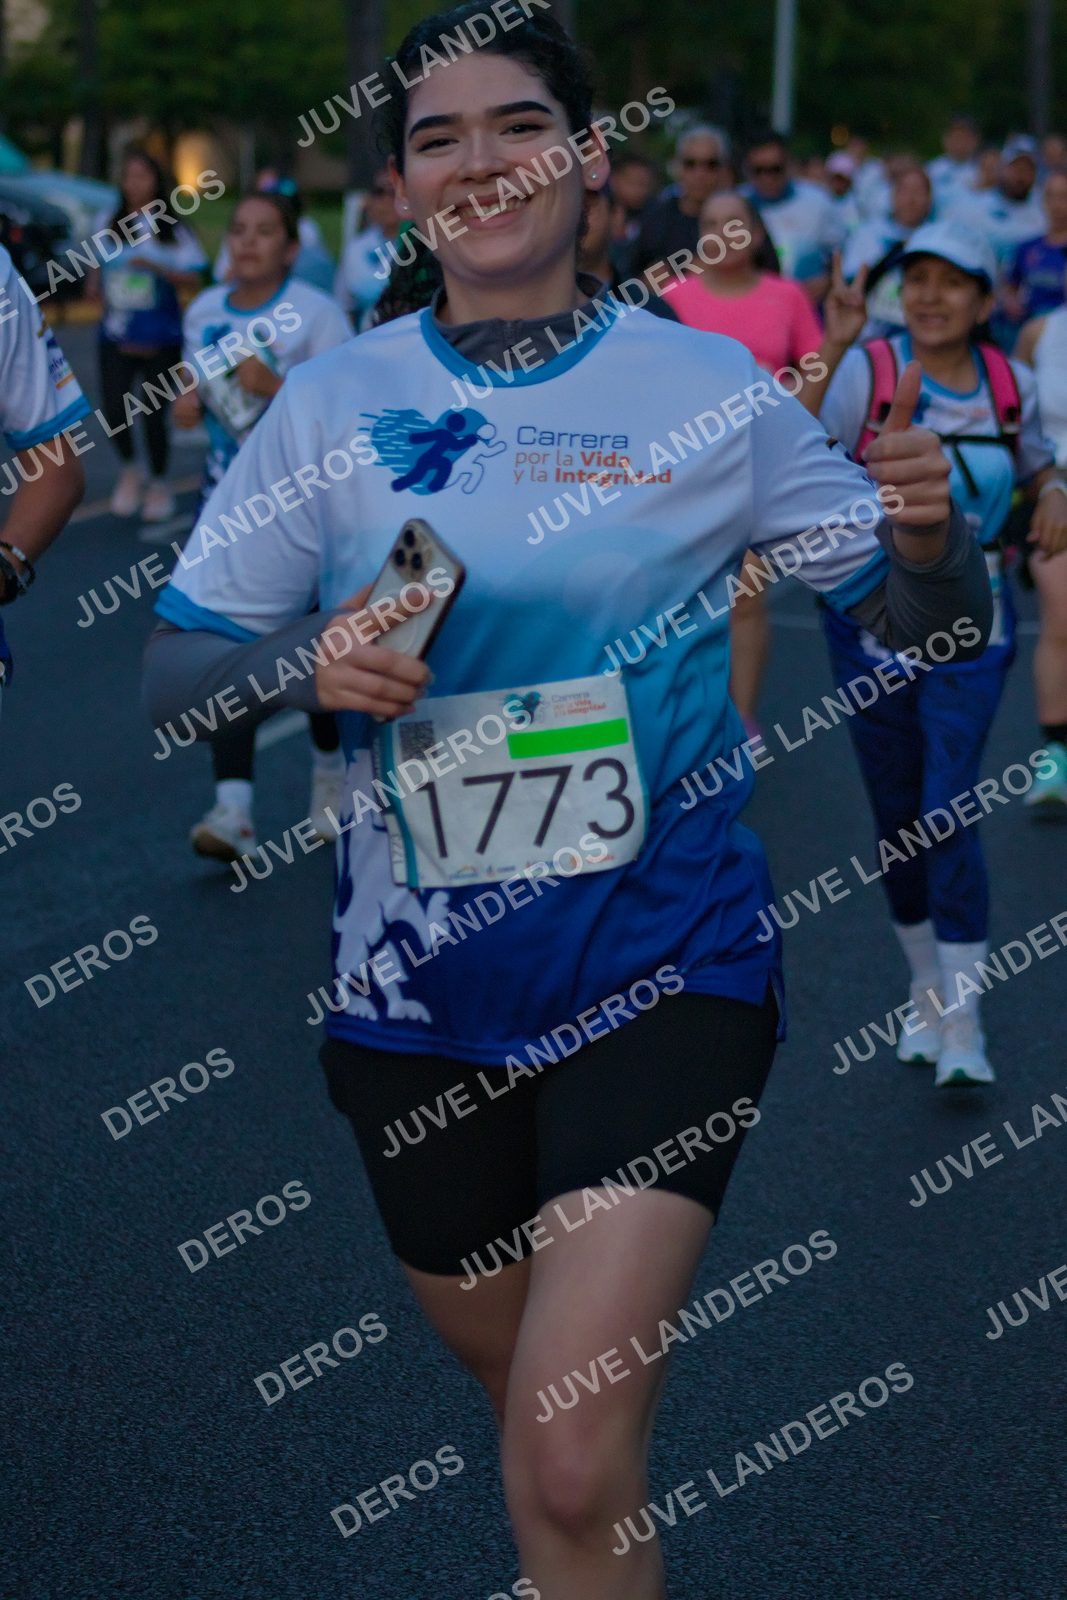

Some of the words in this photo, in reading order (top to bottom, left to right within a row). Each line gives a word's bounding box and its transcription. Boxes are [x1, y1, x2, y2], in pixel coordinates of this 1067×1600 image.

[517, 426, 629, 449] Carrera
[515, 452, 549, 467] por
[556, 450, 574, 466] la
[580, 451, 631, 468] Vida
[513, 469, 525, 485] y
[530, 466, 548, 482] la
[555, 467, 672, 488] Integridad
[415, 757, 635, 859] 1773
